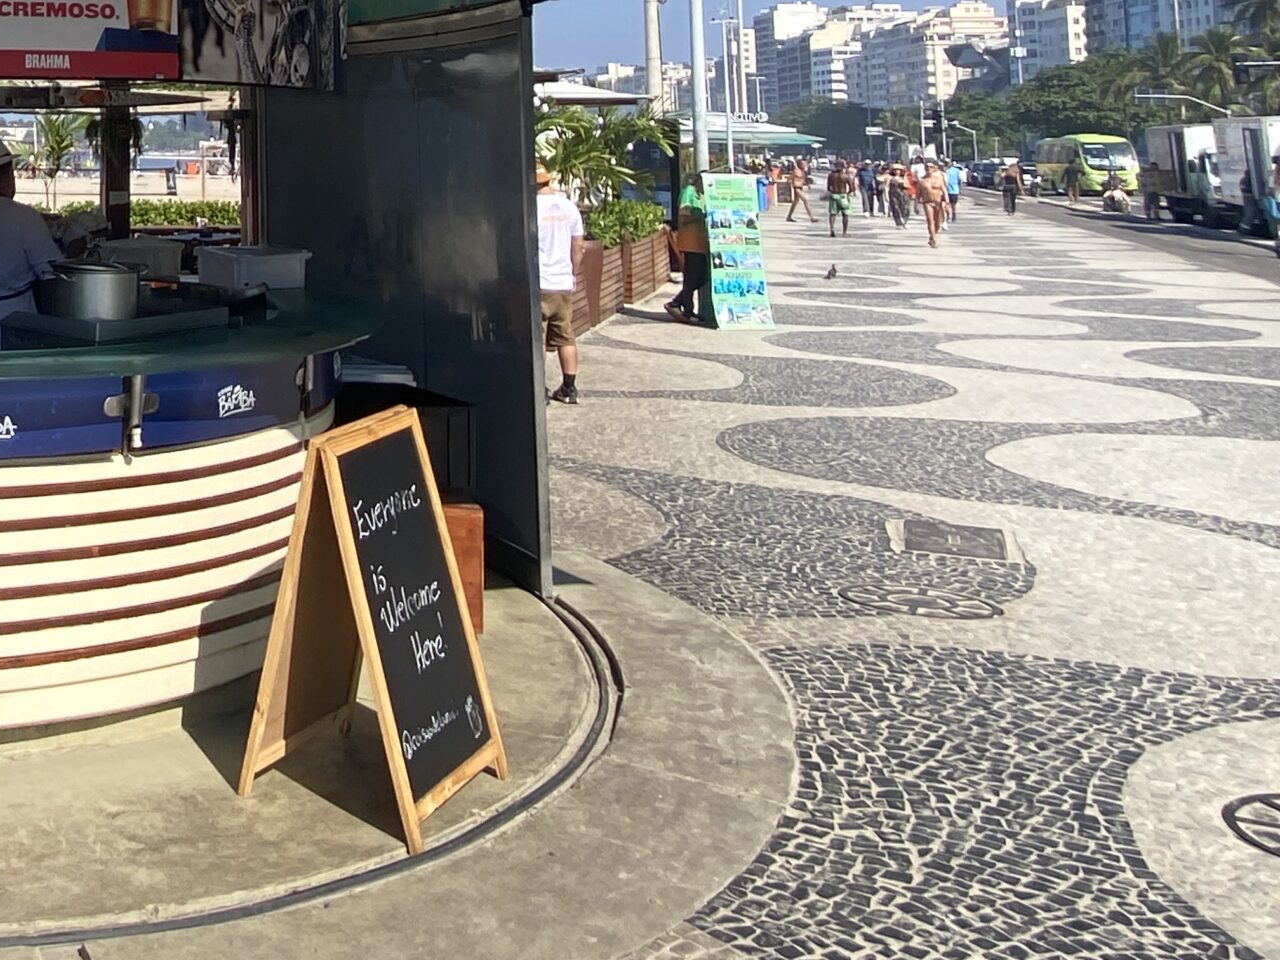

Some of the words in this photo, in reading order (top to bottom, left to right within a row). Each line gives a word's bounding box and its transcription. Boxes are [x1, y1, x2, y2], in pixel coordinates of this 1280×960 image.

[25, 52, 71, 69] BRAHMA
[218, 389, 257, 418] BAMBA
[353, 483, 421, 540] Everyone
[380, 580, 441, 633] Welcome
